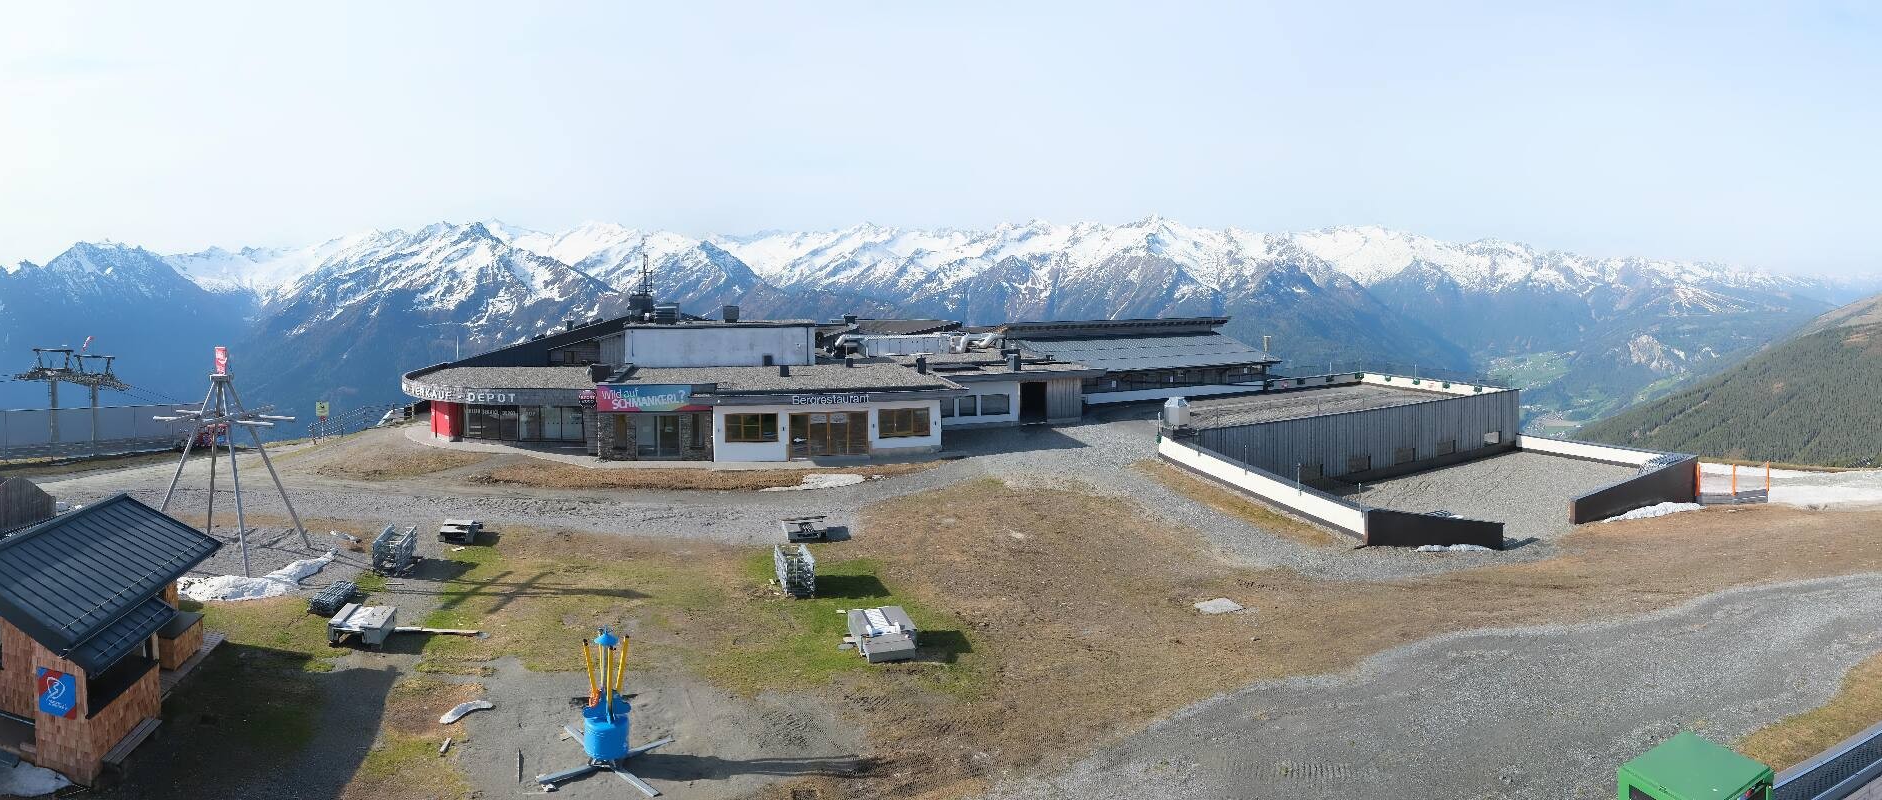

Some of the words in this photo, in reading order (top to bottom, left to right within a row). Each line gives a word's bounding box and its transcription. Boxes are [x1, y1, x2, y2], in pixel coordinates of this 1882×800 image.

[468, 393, 515, 403] DEPOT
[601, 389, 622, 400] Wild
[623, 387, 638, 399] auf
[611, 389, 686, 410] SCHMANKERL?
[792, 393, 870, 405] Bergrestaurant
